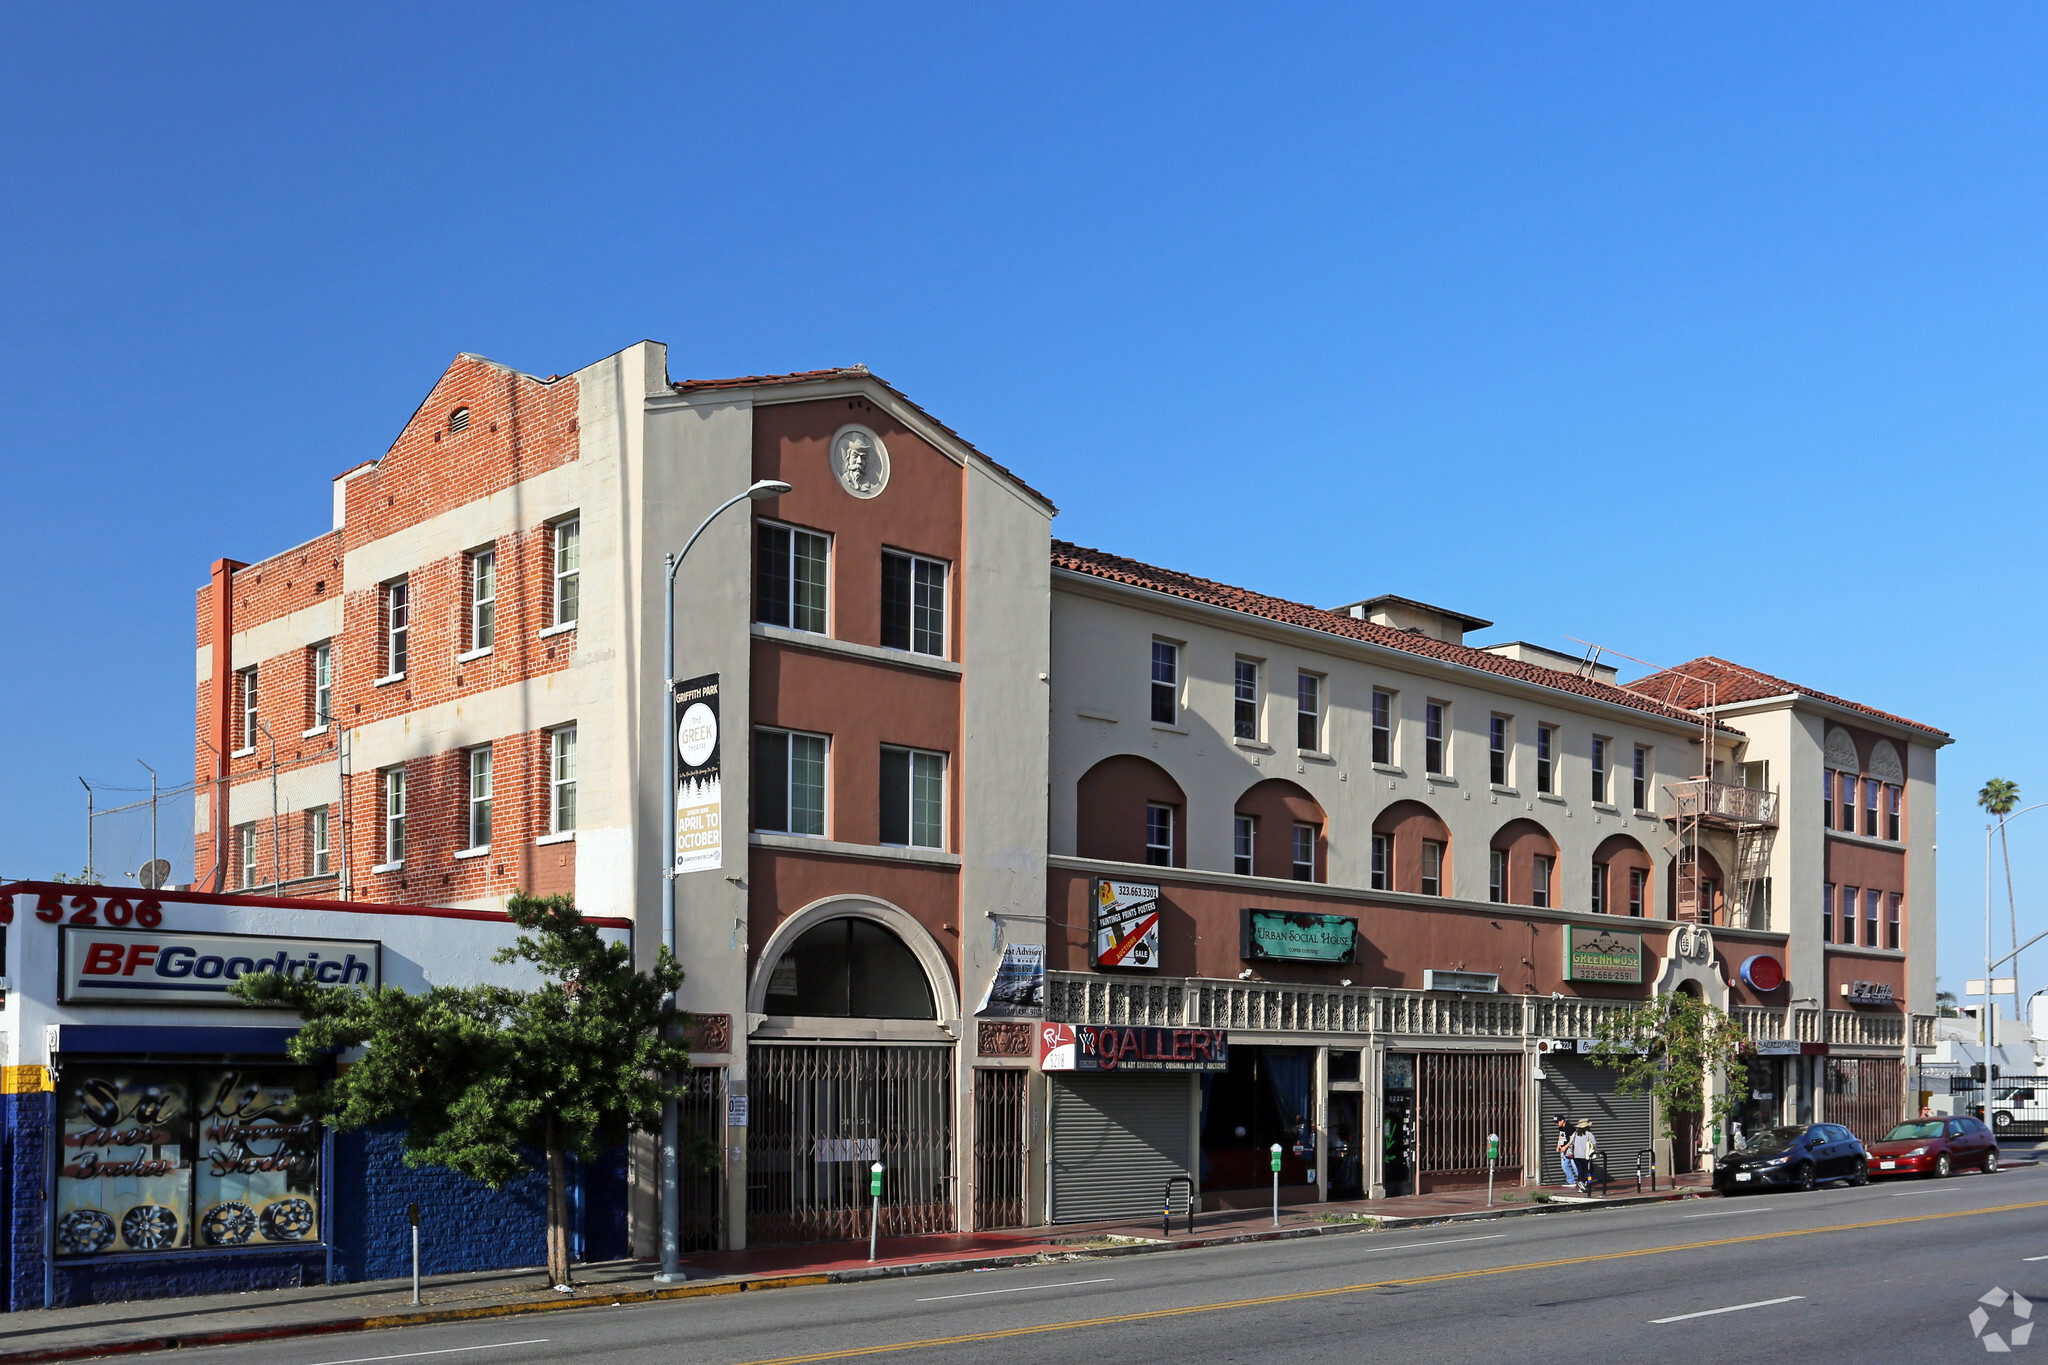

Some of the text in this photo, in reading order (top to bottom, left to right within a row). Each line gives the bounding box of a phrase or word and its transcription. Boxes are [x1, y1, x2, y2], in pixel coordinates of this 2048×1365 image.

[676, 684, 718, 703] GRIFFITH PARK
[692, 716, 702, 725] THE
[682, 724, 712, 745] GREEK
[688, 742, 707, 751] THEATRE
[678, 812, 719, 832] APRIL TO
[678, 829, 720, 849] OCTOBER
[1118, 885, 1157, 899] 323.663.3301
[36, 893, 162, 927] 5206
[1099, 901, 1156, 927] PAINTINGS PRINTS POSTERS
[1257, 927, 1349, 945] URBAN SOCIAL HOUSE
[1015, 946, 1043, 955] Advisor
[1116, 935, 1137, 960] AUCTIONS
[1135, 950, 1148, 958] SALE
[82, 943, 369, 985] BFGoodrich
[1852, 979, 1893, 999] E-Z Life
[1050, 1053, 1065, 1068] 5218
[1127, 1061, 1136, 1069] ART
[1136, 1061, 1163, 1069] EXHIBITIONS
[1185, 1062, 1194, 1070] ART
[1194, 1062, 1204, 1070] SALE
[1206, 1062, 1226, 1070] AUCTIONS
